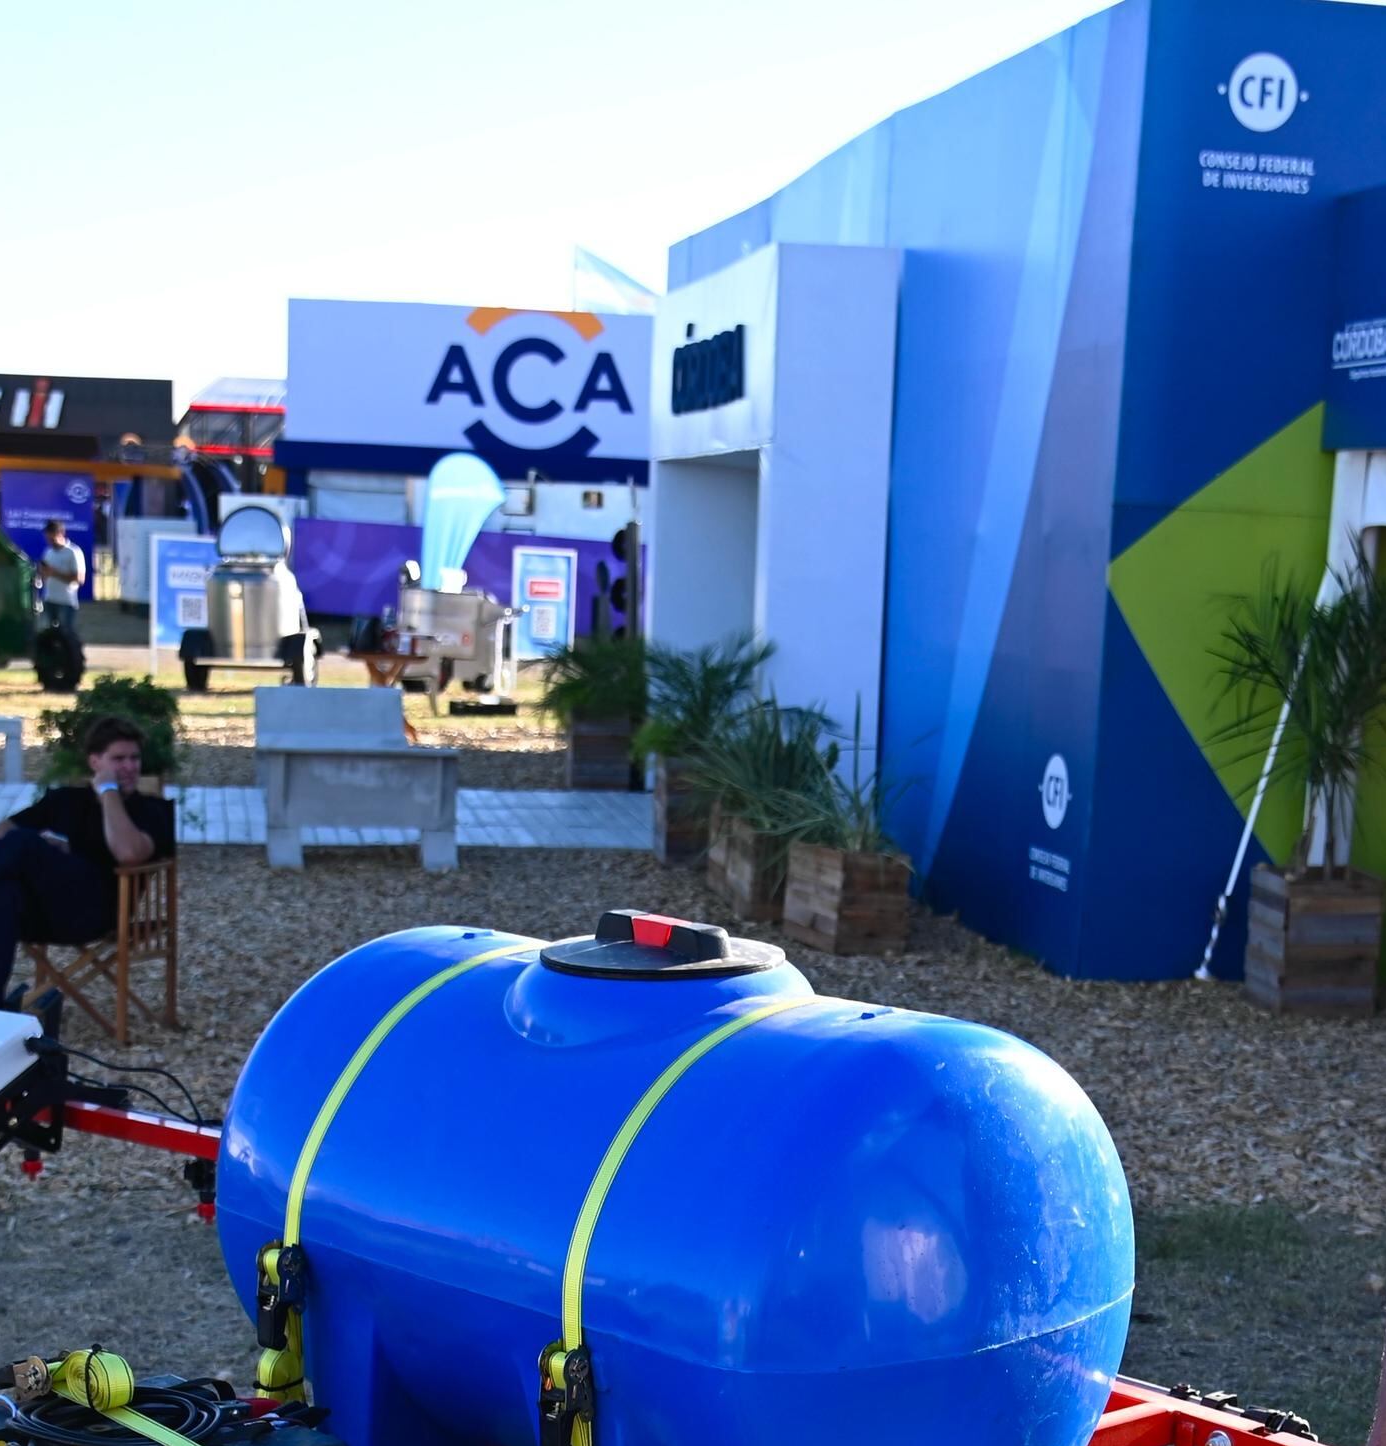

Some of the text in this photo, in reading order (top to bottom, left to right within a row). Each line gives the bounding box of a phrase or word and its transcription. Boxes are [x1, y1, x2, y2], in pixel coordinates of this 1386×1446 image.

[1239, 75, 1286, 111] CFI
[1199, 150, 1315, 177] CONSEJO FEDERAL
[1202, 169, 1310, 195] DE INVERSIONES
[425, 337, 634, 425] ACA
